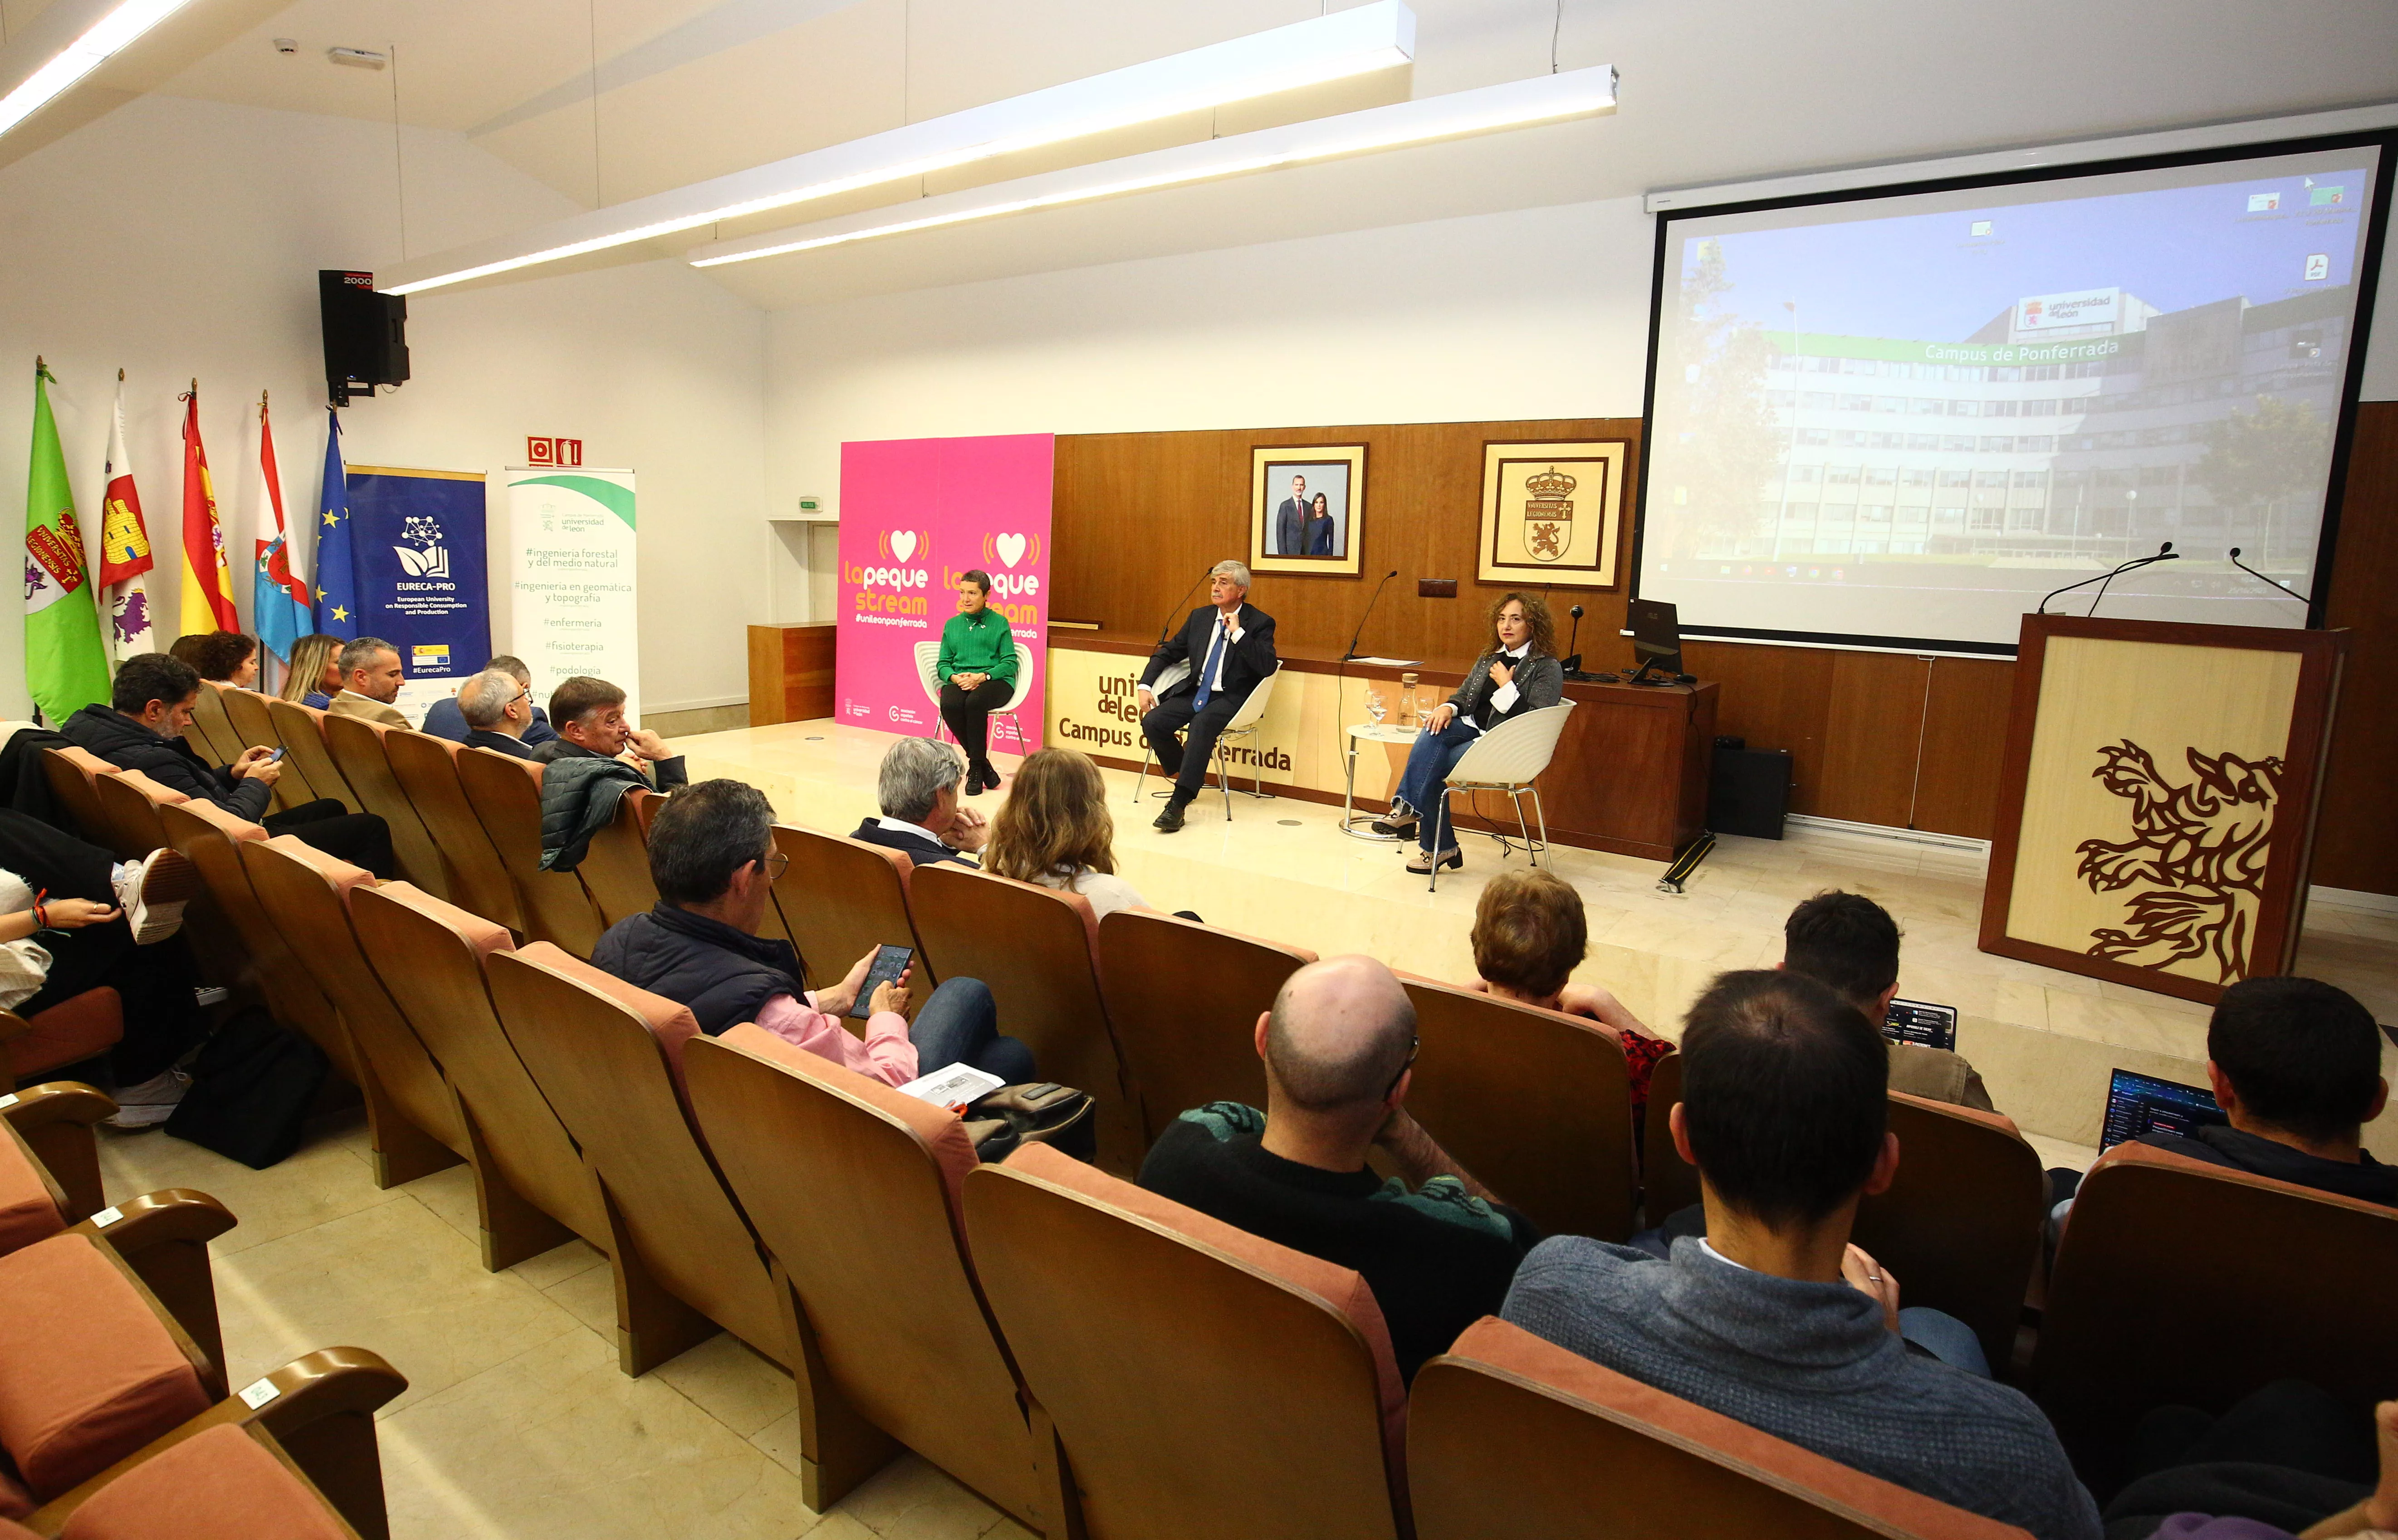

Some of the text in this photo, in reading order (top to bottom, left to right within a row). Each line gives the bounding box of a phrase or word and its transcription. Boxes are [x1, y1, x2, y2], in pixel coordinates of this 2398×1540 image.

[344, 277, 372, 285] 2000
[2048, 295, 2111, 311] universidad
[2056, 308, 2079, 319] león
[1925, 339, 2119, 364] Campus de Ponferrada
[37, 527, 71, 567] VNIVERSITAS
[582, 548, 617, 558] forestal
[528, 557, 618, 568] y del medio natural
[396, 582, 456, 591] EURECA-PRO
[583, 582, 631, 593] geomática
[545, 593, 601, 604] y topografía
[856, 587, 927, 616] stream
[855, 613, 927, 628] #unileonponferrada
[545, 641, 604, 653] #fisioterapia
[549, 665, 601, 677] #podología
[1059, 717, 1132, 748] Campus
